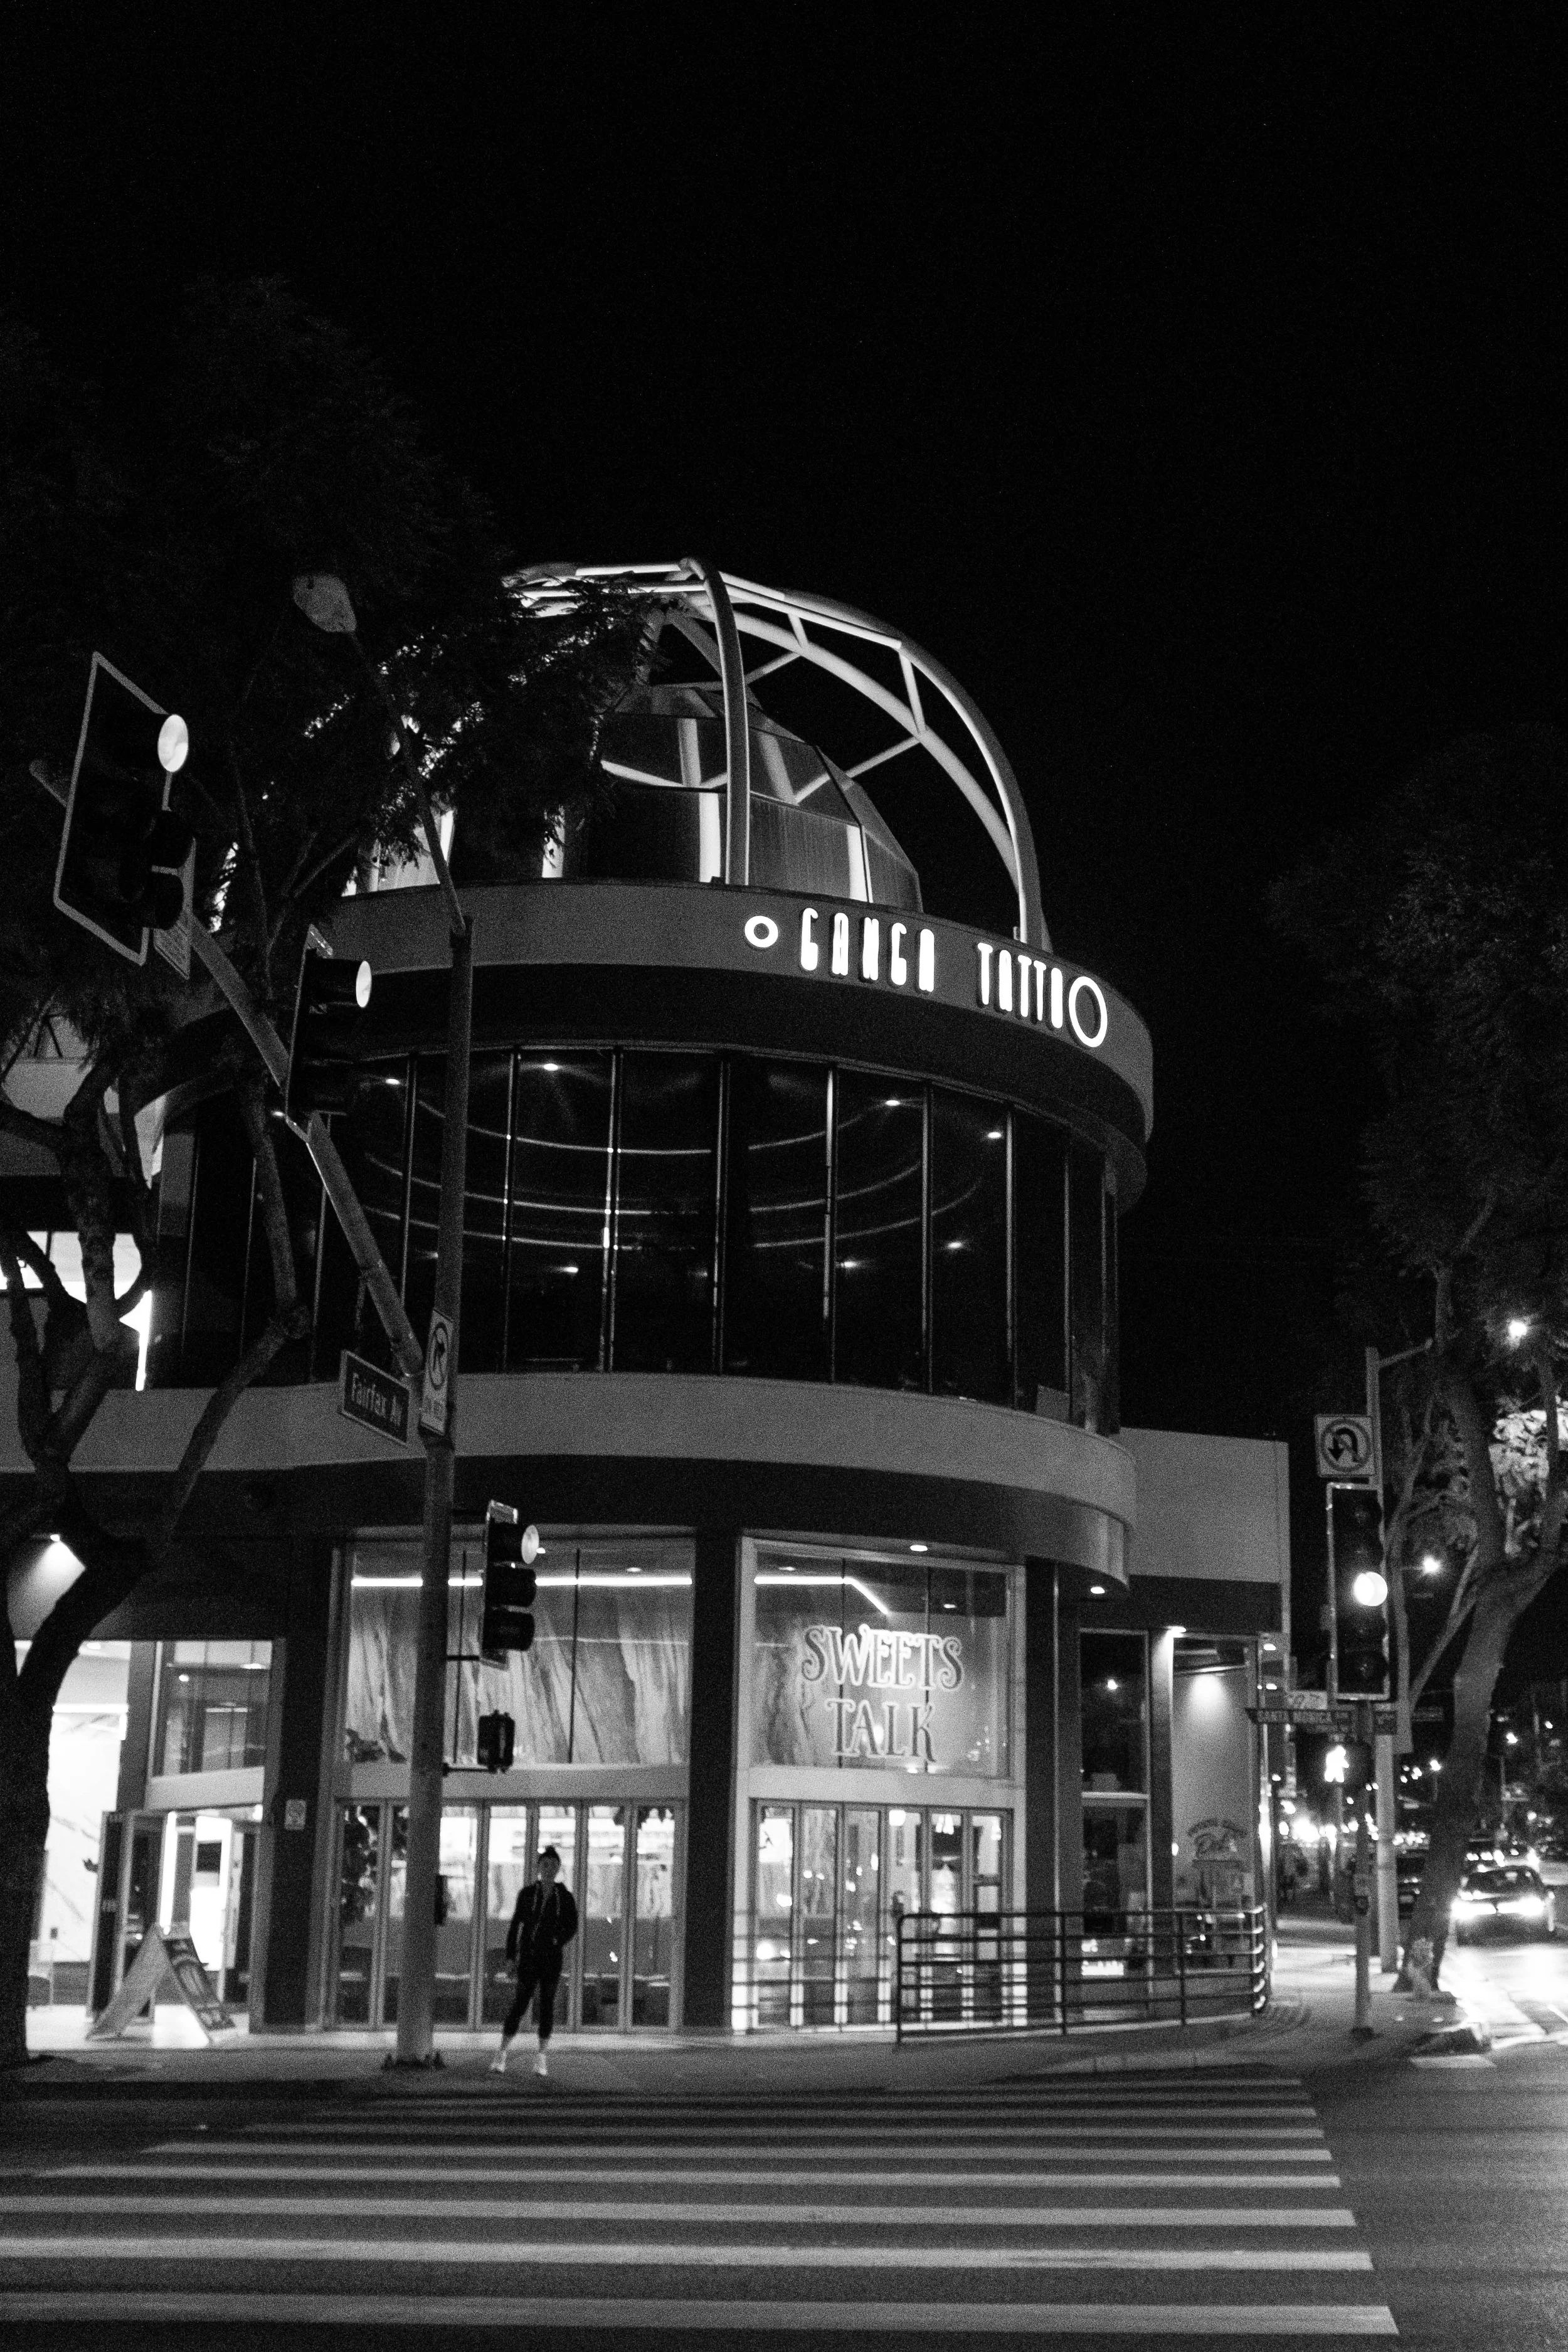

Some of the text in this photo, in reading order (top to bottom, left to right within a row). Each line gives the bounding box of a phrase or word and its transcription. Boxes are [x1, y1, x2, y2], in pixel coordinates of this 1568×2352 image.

[800, 907, 1108, 1048] GANGA TATTOO
[351, 1372, 387, 1419] Fairfax
[801, 1623, 965, 1692] SWEETS
[824, 1697, 936, 1764] TALK
[1256, 1710, 1289, 1723] SANTA
